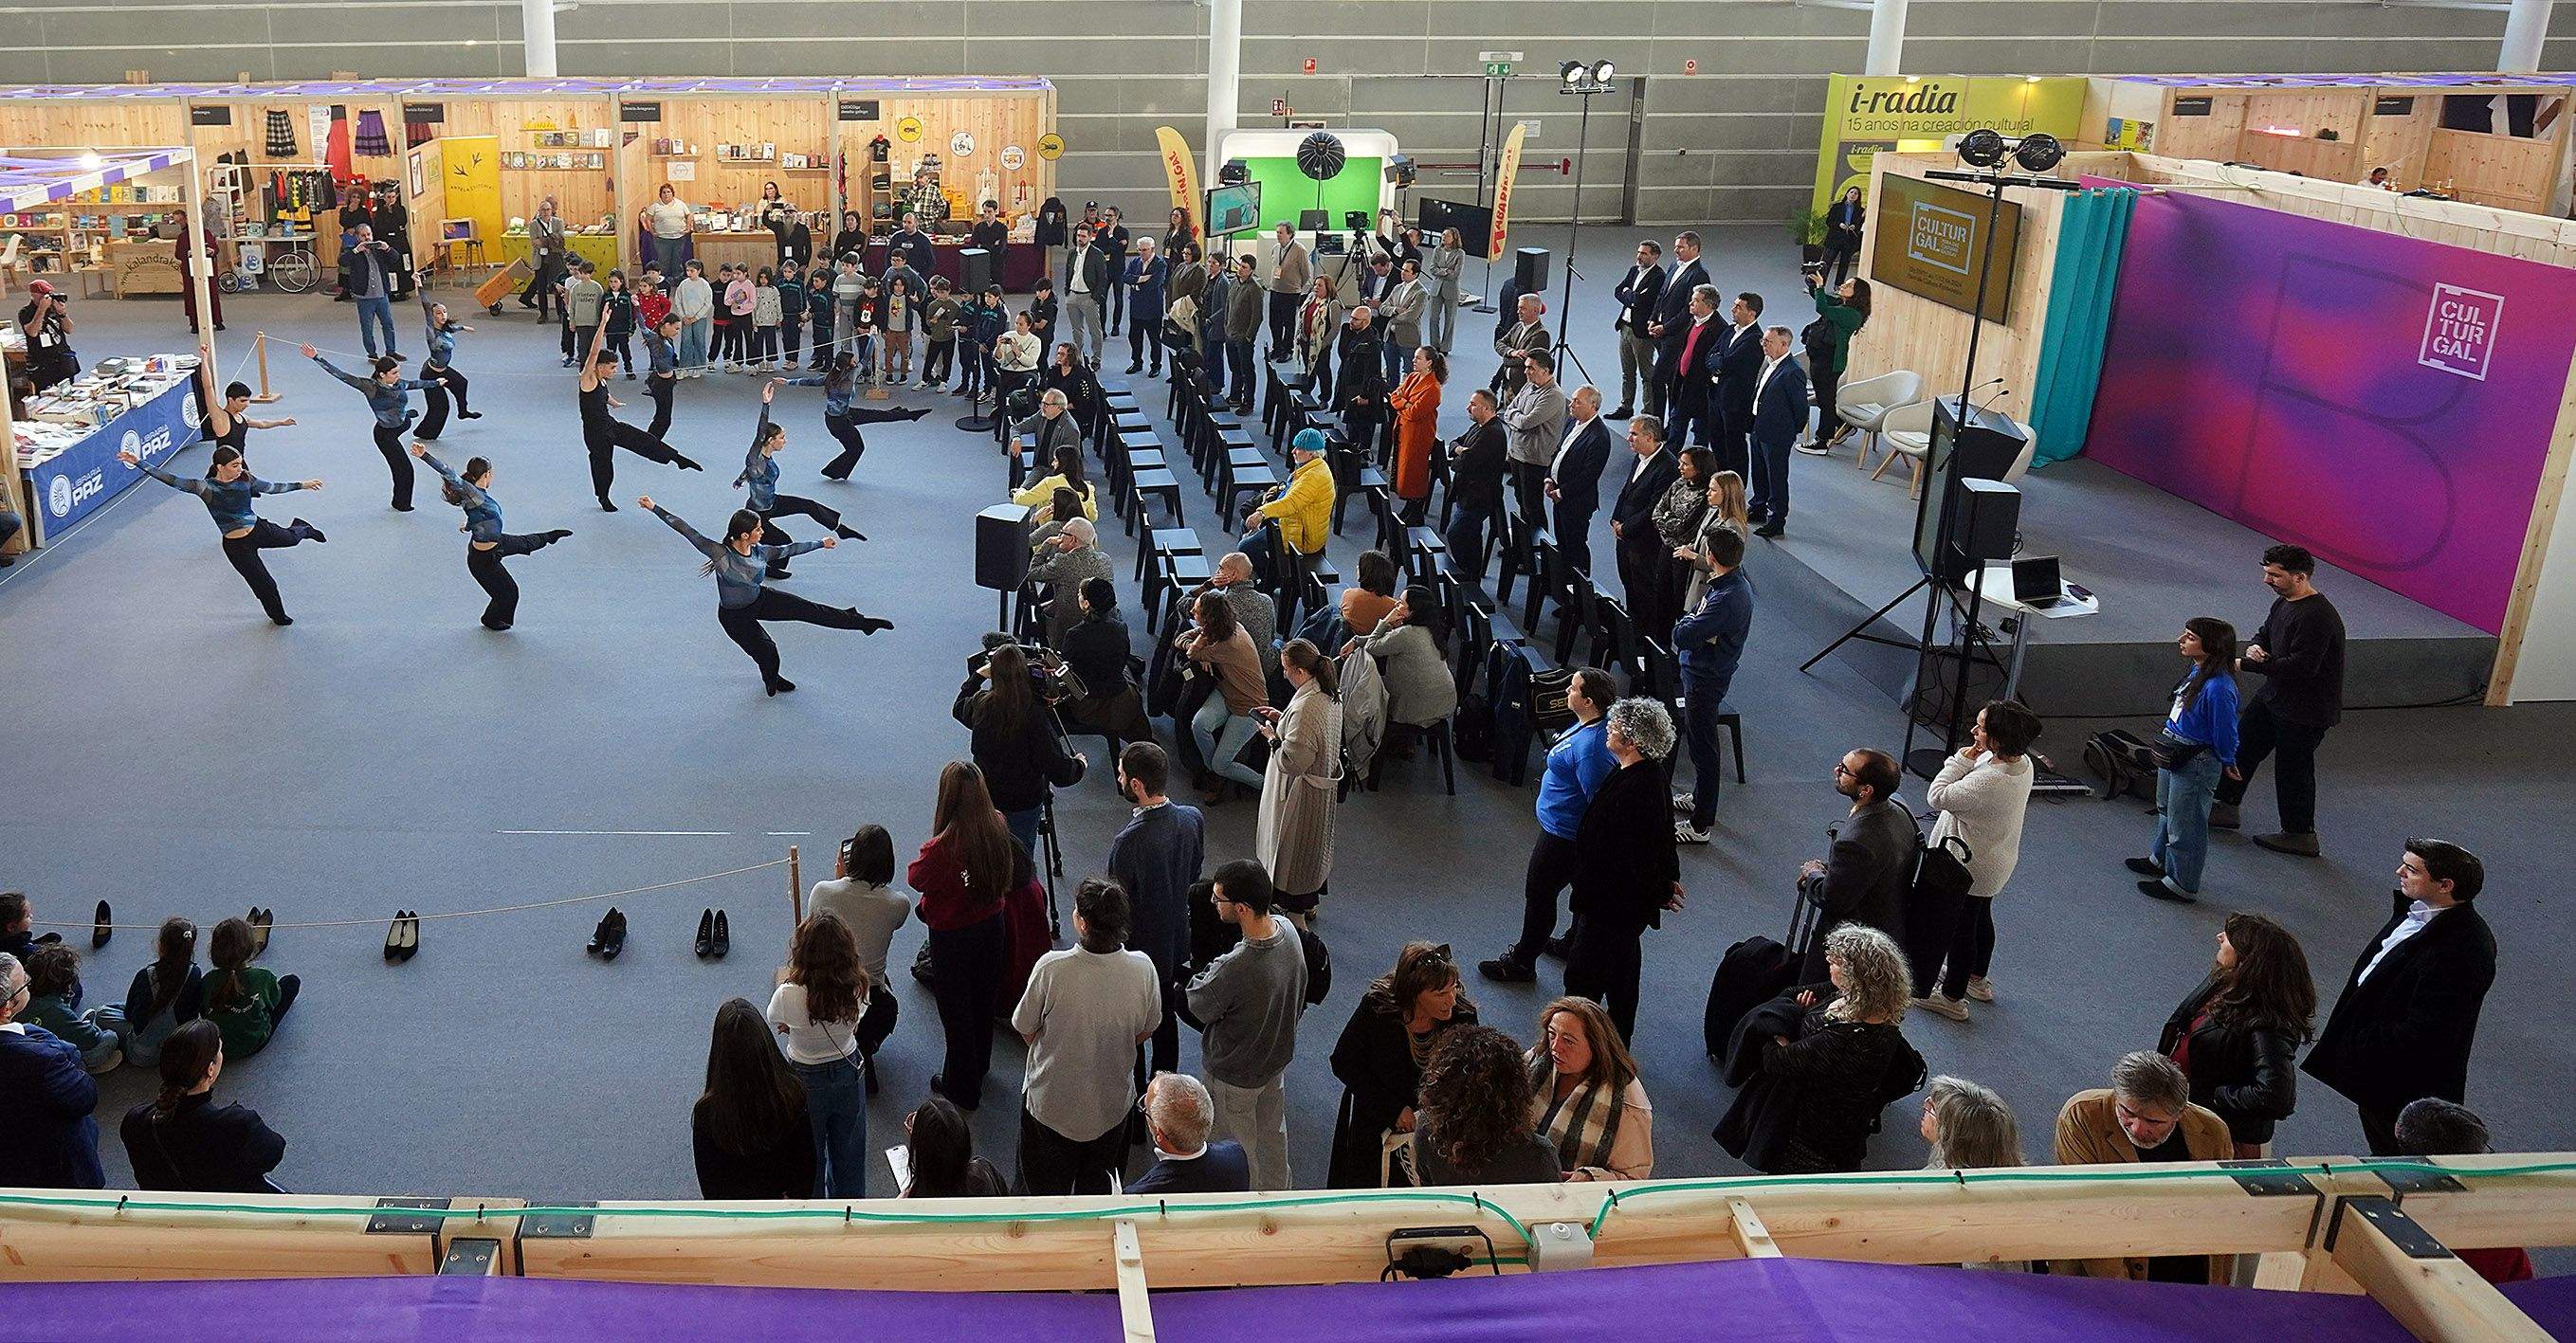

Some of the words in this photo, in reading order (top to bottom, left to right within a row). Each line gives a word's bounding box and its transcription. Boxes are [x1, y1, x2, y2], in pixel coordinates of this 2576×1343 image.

[1850, 83, 1958, 114] i-radia
[1848, 118, 1862, 132] 15
[1865, 119, 1899, 132] anos
[1902, 119, 1919, 132] na
[1921, 118, 1982, 133] creación
[1983, 118, 2036, 132] cultural
[1915, 231, 1940, 252] GAL
[1917, 216, 1967, 243] CULTUR
[2440, 300, 2486, 327] CUL
[2439, 318, 2484, 345] TUR
[2432, 336, 2477, 362] GAL
[141, 430, 172, 461] PAZ
[72, 473, 104, 507] PAZ
